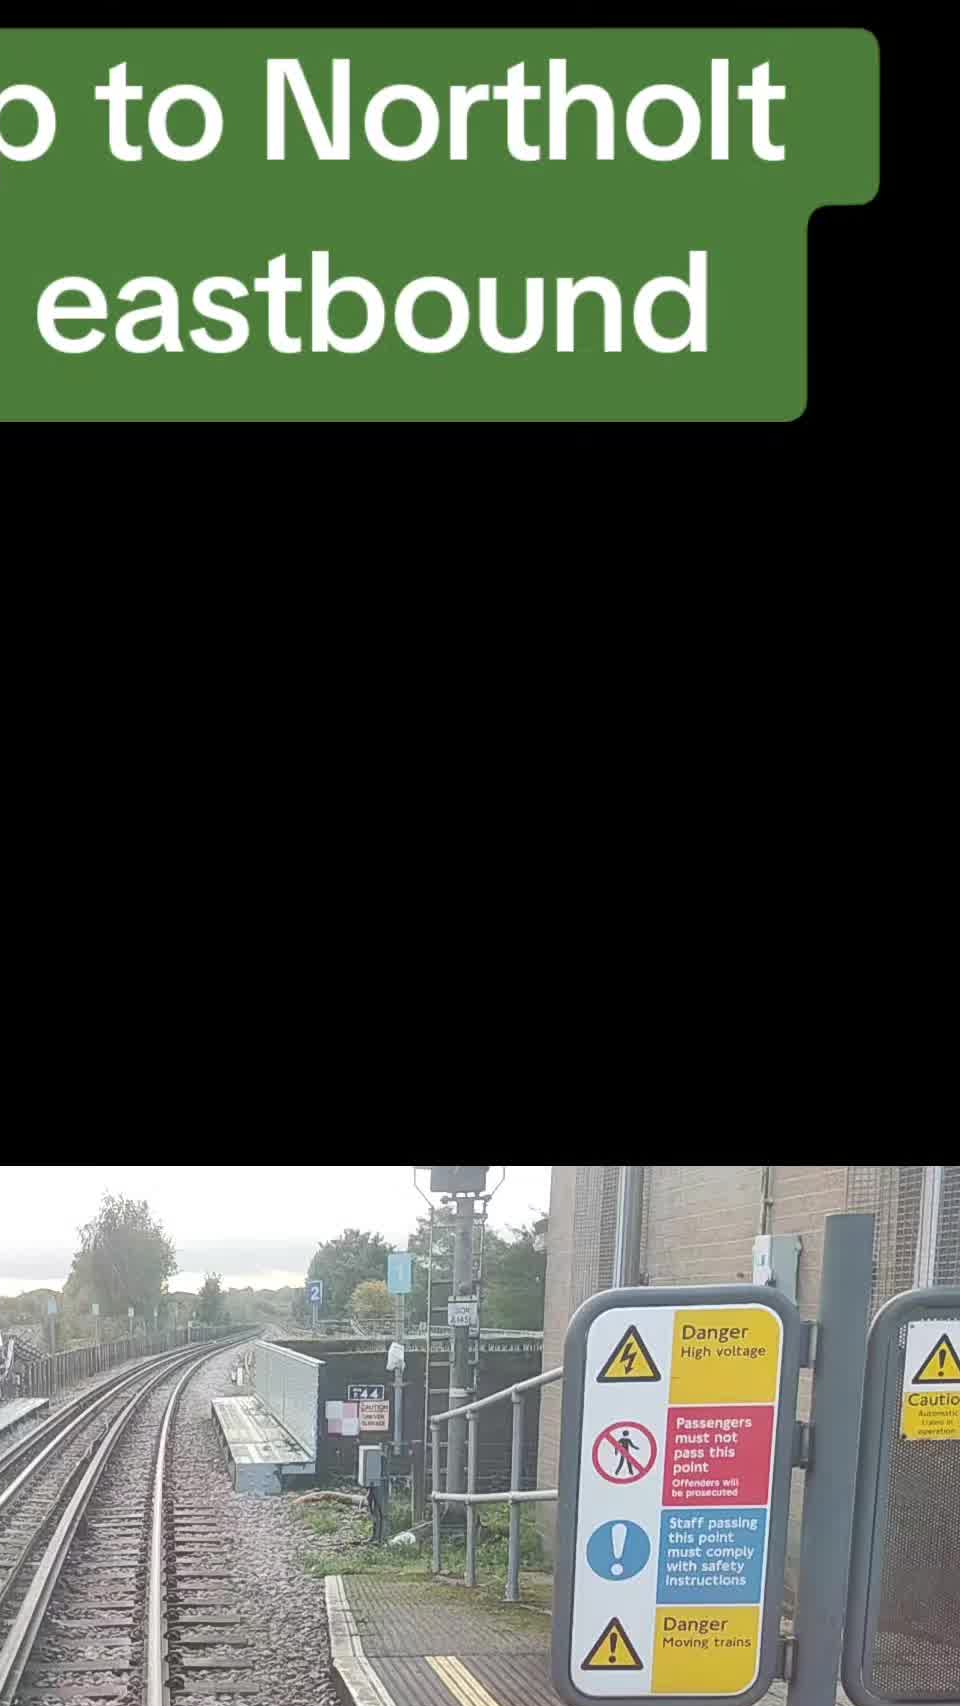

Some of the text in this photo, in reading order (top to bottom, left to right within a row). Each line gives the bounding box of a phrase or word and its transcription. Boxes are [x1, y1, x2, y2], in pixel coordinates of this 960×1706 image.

[311, 1286, 321, 1300] 2
[682, 1324, 749, 1343] Danger
[680, 1345, 767, 1360] High voltage
[676, 1417, 752, 1431] Passengers
[675, 1432, 738, 1444] must not
[674, 1446, 736, 1461] pass this
[673, 1461, 709, 1476] point
[672, 1478, 739, 1488] Offenders will
[672, 1488, 738, 1499] be prosecuted
[669, 1516, 758, 1531] Staff passing
[668, 1531, 735, 1546] this point
[667, 1546, 754, 1560] must comply
[666, 1560, 744, 1574] with safety
[665, 1574, 746, 1587] instructions
[663, 1616, 728, 1634] Danger
[662, 1637, 752, 1649] Moving trains
